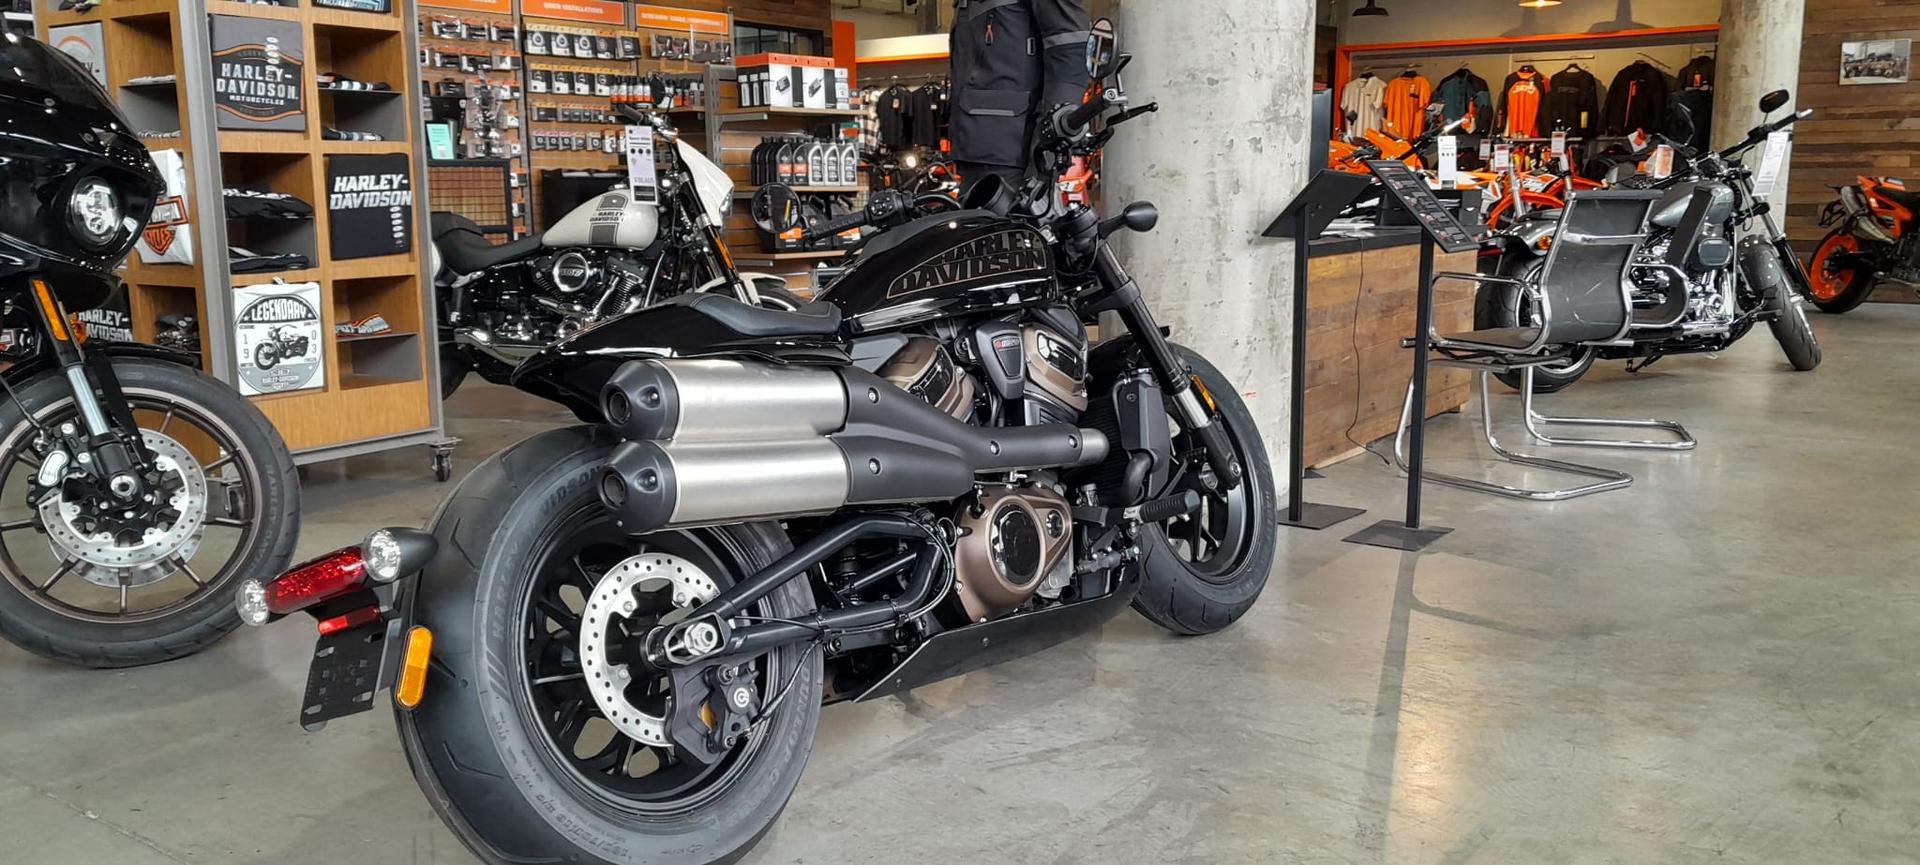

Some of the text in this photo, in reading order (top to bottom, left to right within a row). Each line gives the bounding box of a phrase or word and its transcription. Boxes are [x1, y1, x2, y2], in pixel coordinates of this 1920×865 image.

[334, 174, 409, 192] HARLEY-
[329, 190, 412, 210] DAVIDSON
[896, 250, 1044, 291] DAVIDSON
[251, 298, 307, 321] LEGENDARY
[86, 322, 134, 342] AVIDSON
